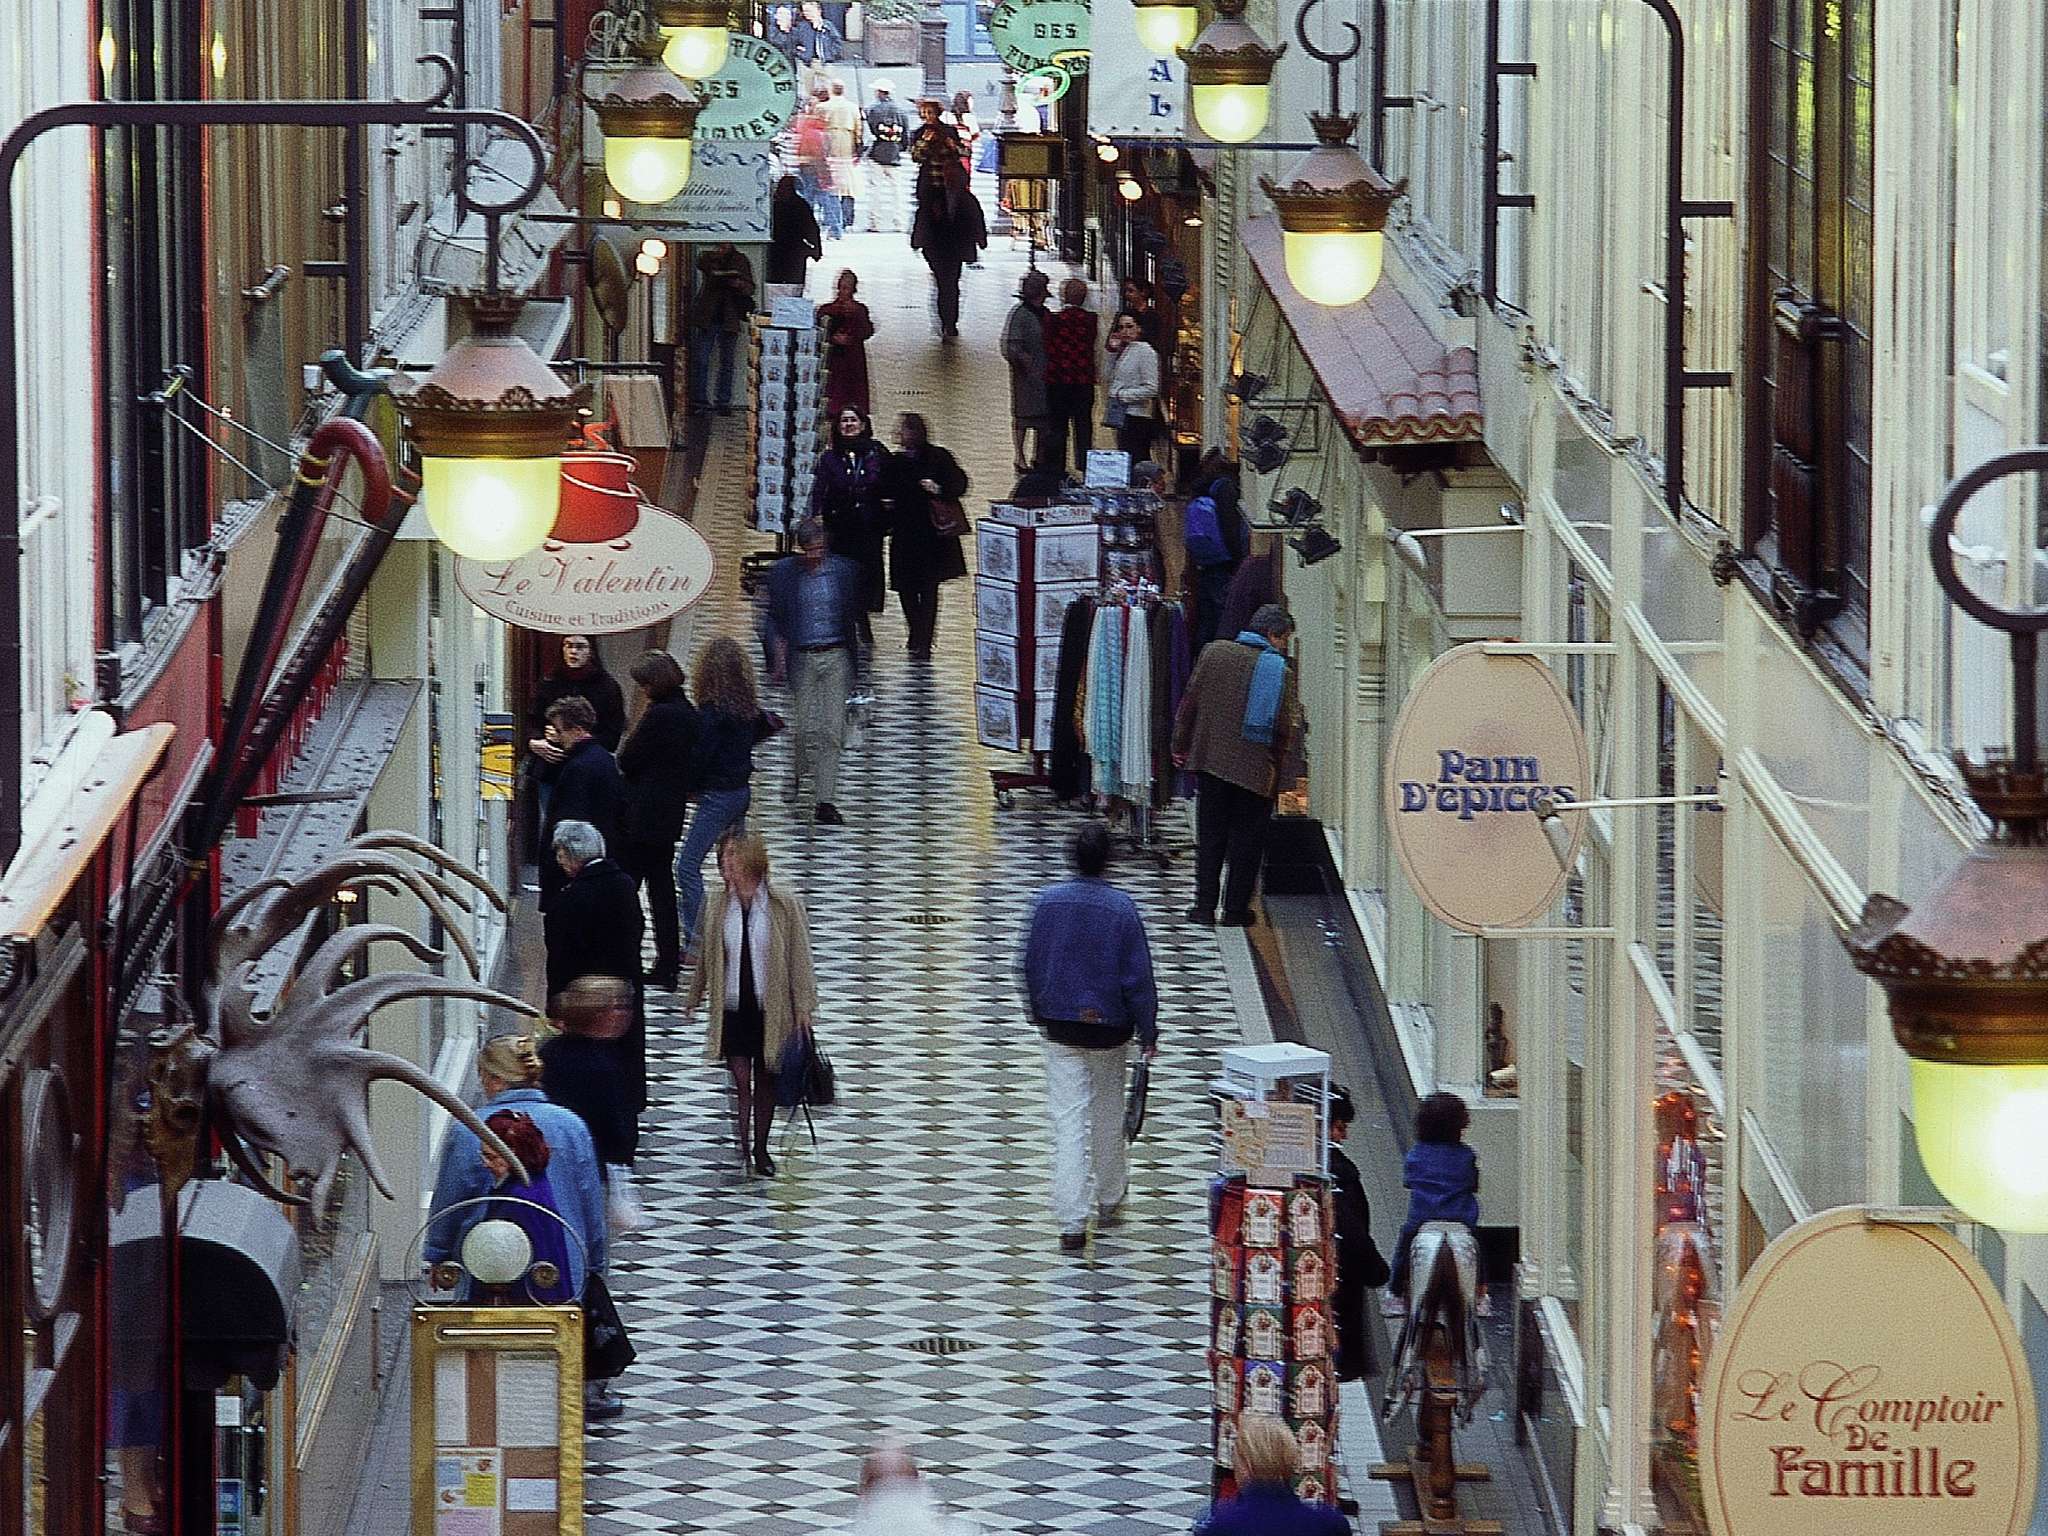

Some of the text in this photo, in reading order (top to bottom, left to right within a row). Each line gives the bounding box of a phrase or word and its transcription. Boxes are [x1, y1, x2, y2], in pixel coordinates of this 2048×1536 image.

[478, 556, 694, 597] Le Valentin
[503, 599, 671, 627] Cuisine et Traditions
[1439, 750, 1540, 784] Pain
[1731, 1359, 2004, 1443] Le Comptoir
[1844, 1423, 1889, 1452] De
[1769, 1445, 1978, 1497] Famille
